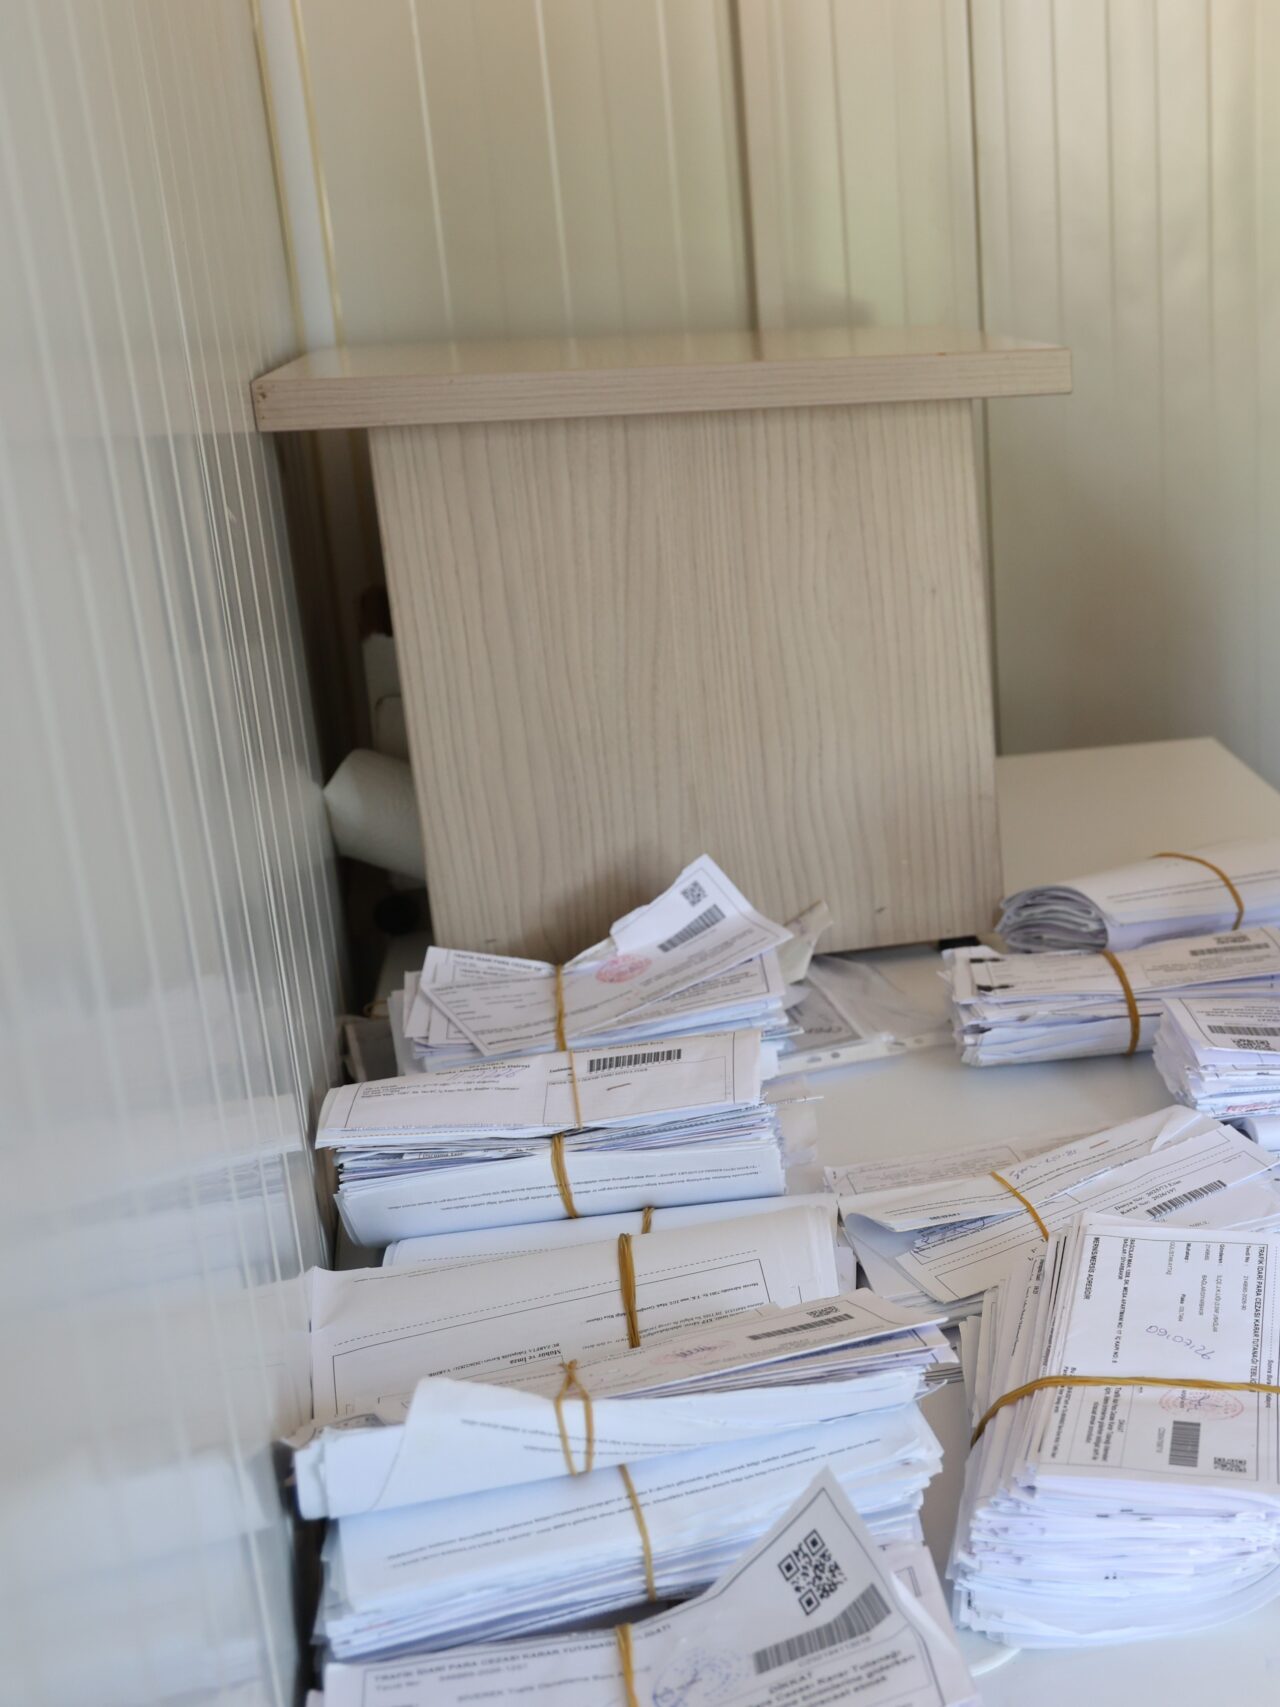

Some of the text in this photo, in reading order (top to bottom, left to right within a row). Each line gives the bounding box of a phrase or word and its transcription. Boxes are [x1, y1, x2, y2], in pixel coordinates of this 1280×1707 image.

[1083, 1273, 1094, 1300] ADRESİDİR
[1250, 1245, 1265, 1364] TRAFİK İDARİ PARA CEZASI KARAR TUTANAĞI
[508, 1347, 561, 1365] Mühür ve İmza
[447, 1659, 478, 1673] PARA
[523, 1647, 560, 1662] KARAR
[815, 1668, 848, 1687] Karar
